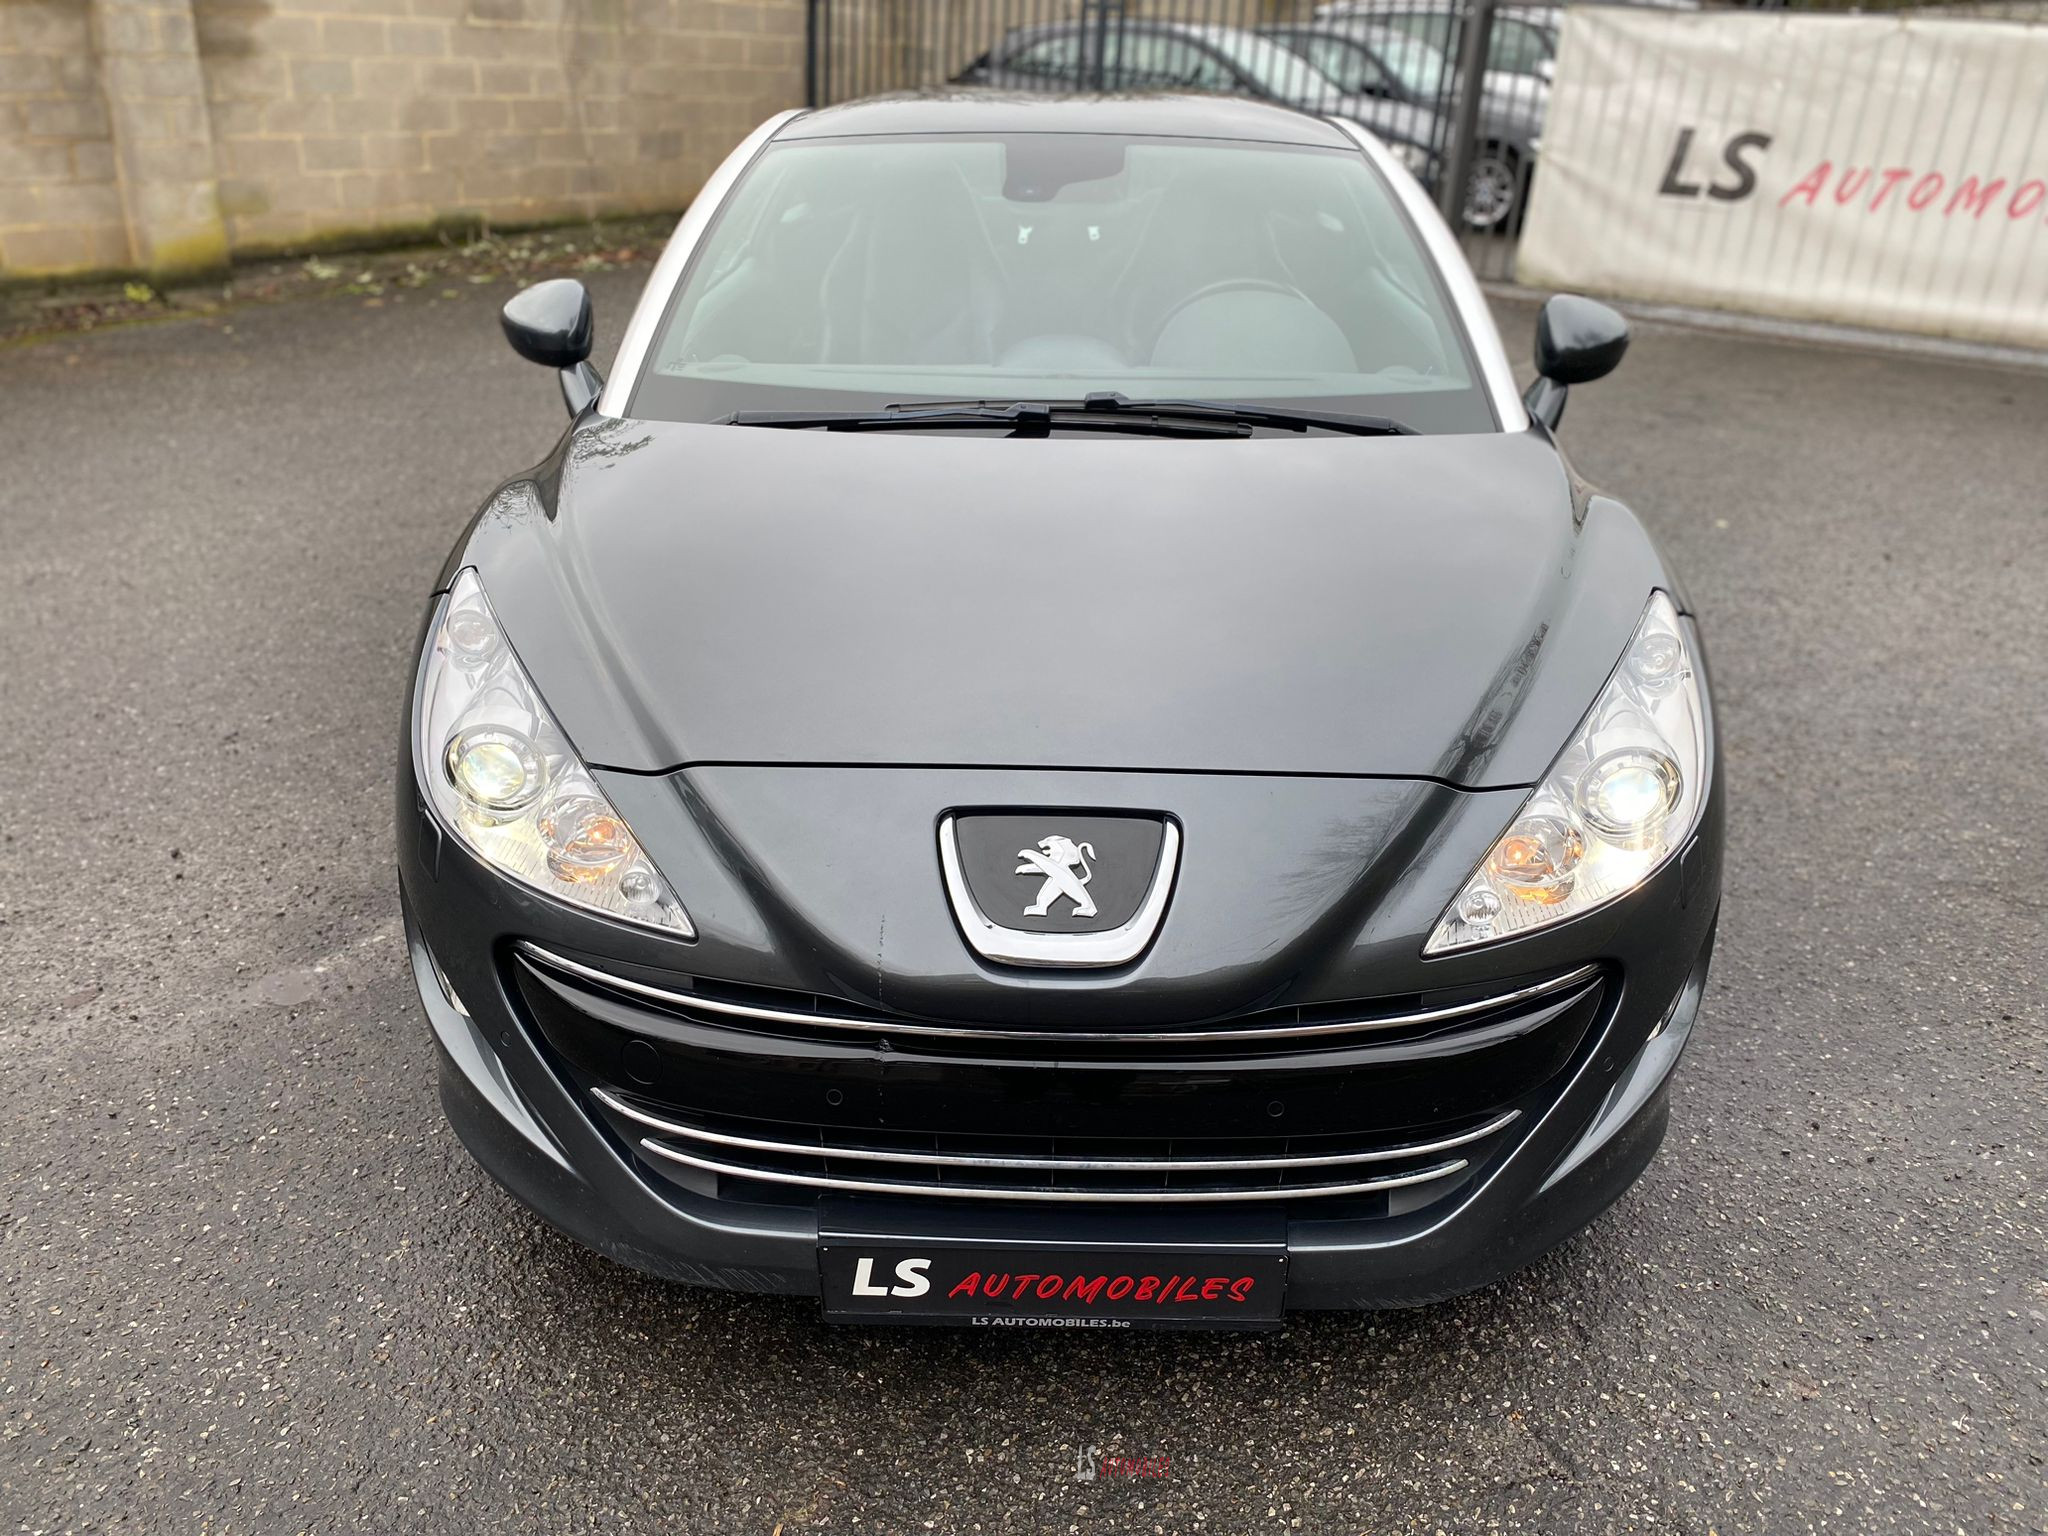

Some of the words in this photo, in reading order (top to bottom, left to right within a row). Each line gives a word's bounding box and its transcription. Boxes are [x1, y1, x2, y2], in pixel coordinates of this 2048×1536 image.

[1658, 127, 1773, 201] LS
[1779, 160, 2048, 227] AUTOMO
[852, 1257, 931, 1297] LS
[948, 1271, 1255, 1304] AUTOMOBILES
[972, 1317, 989, 1326] LS
[992, 1317, 1131, 1328] AUTOMOBILES.be
